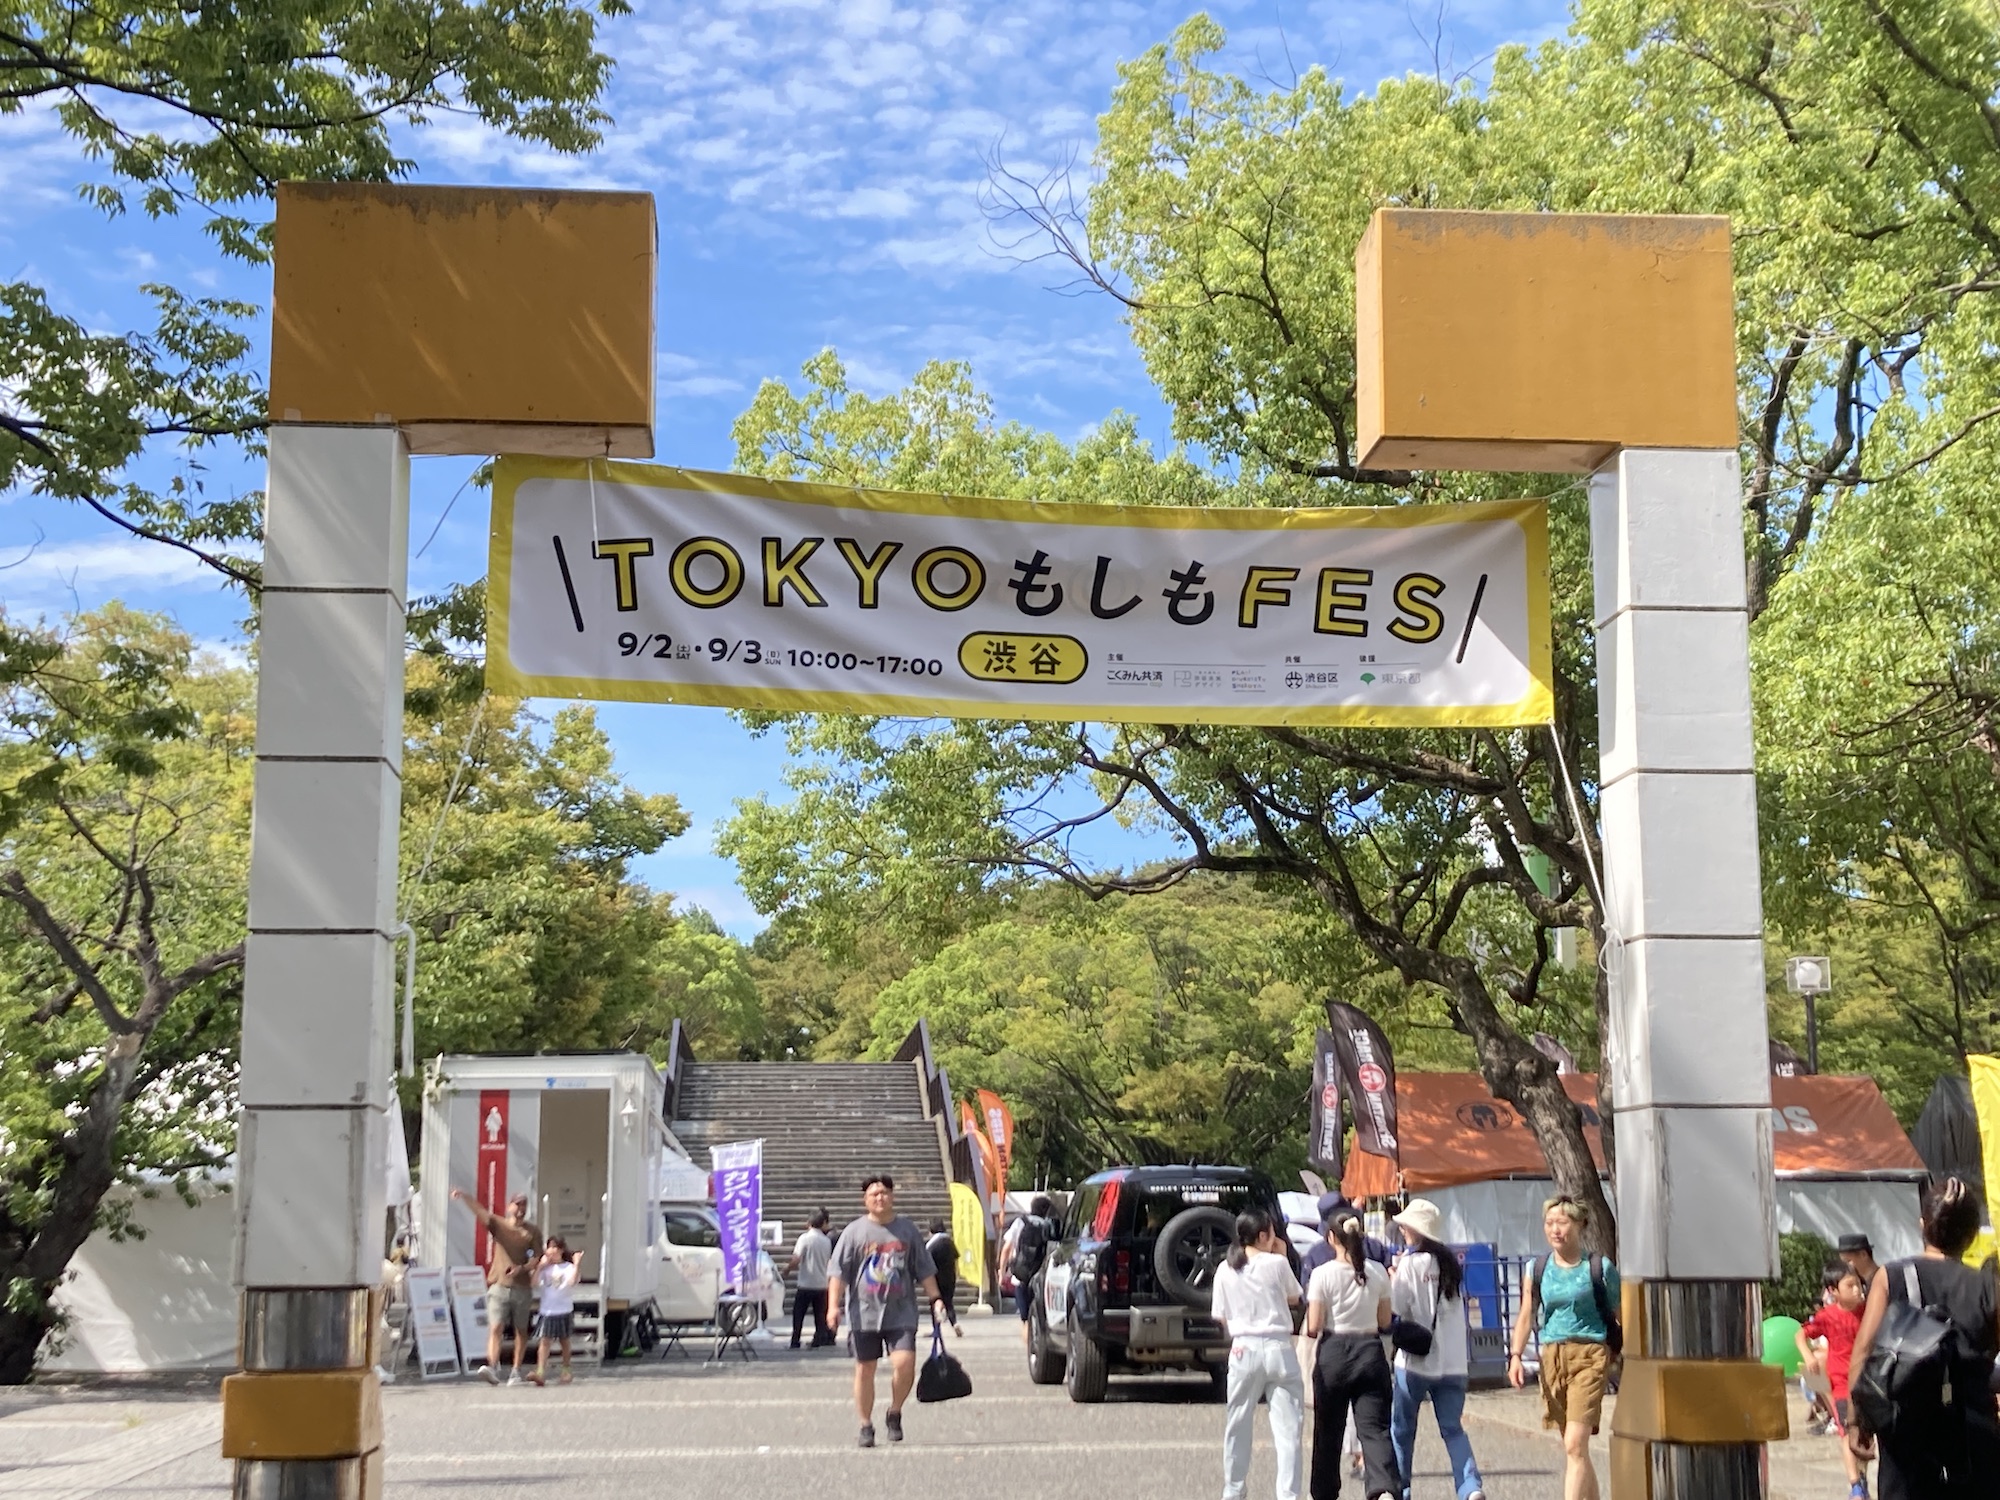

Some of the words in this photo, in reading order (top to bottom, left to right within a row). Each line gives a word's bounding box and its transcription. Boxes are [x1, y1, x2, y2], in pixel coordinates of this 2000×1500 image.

[617, 632, 672, 660] 9/2
[982, 640, 1062, 676] 渋谷
[1107, 670, 1163, 681] こくみん共済
[1304, 672, 1339, 683] 渋谷区
[1381, 672, 1422, 685] 東京都
